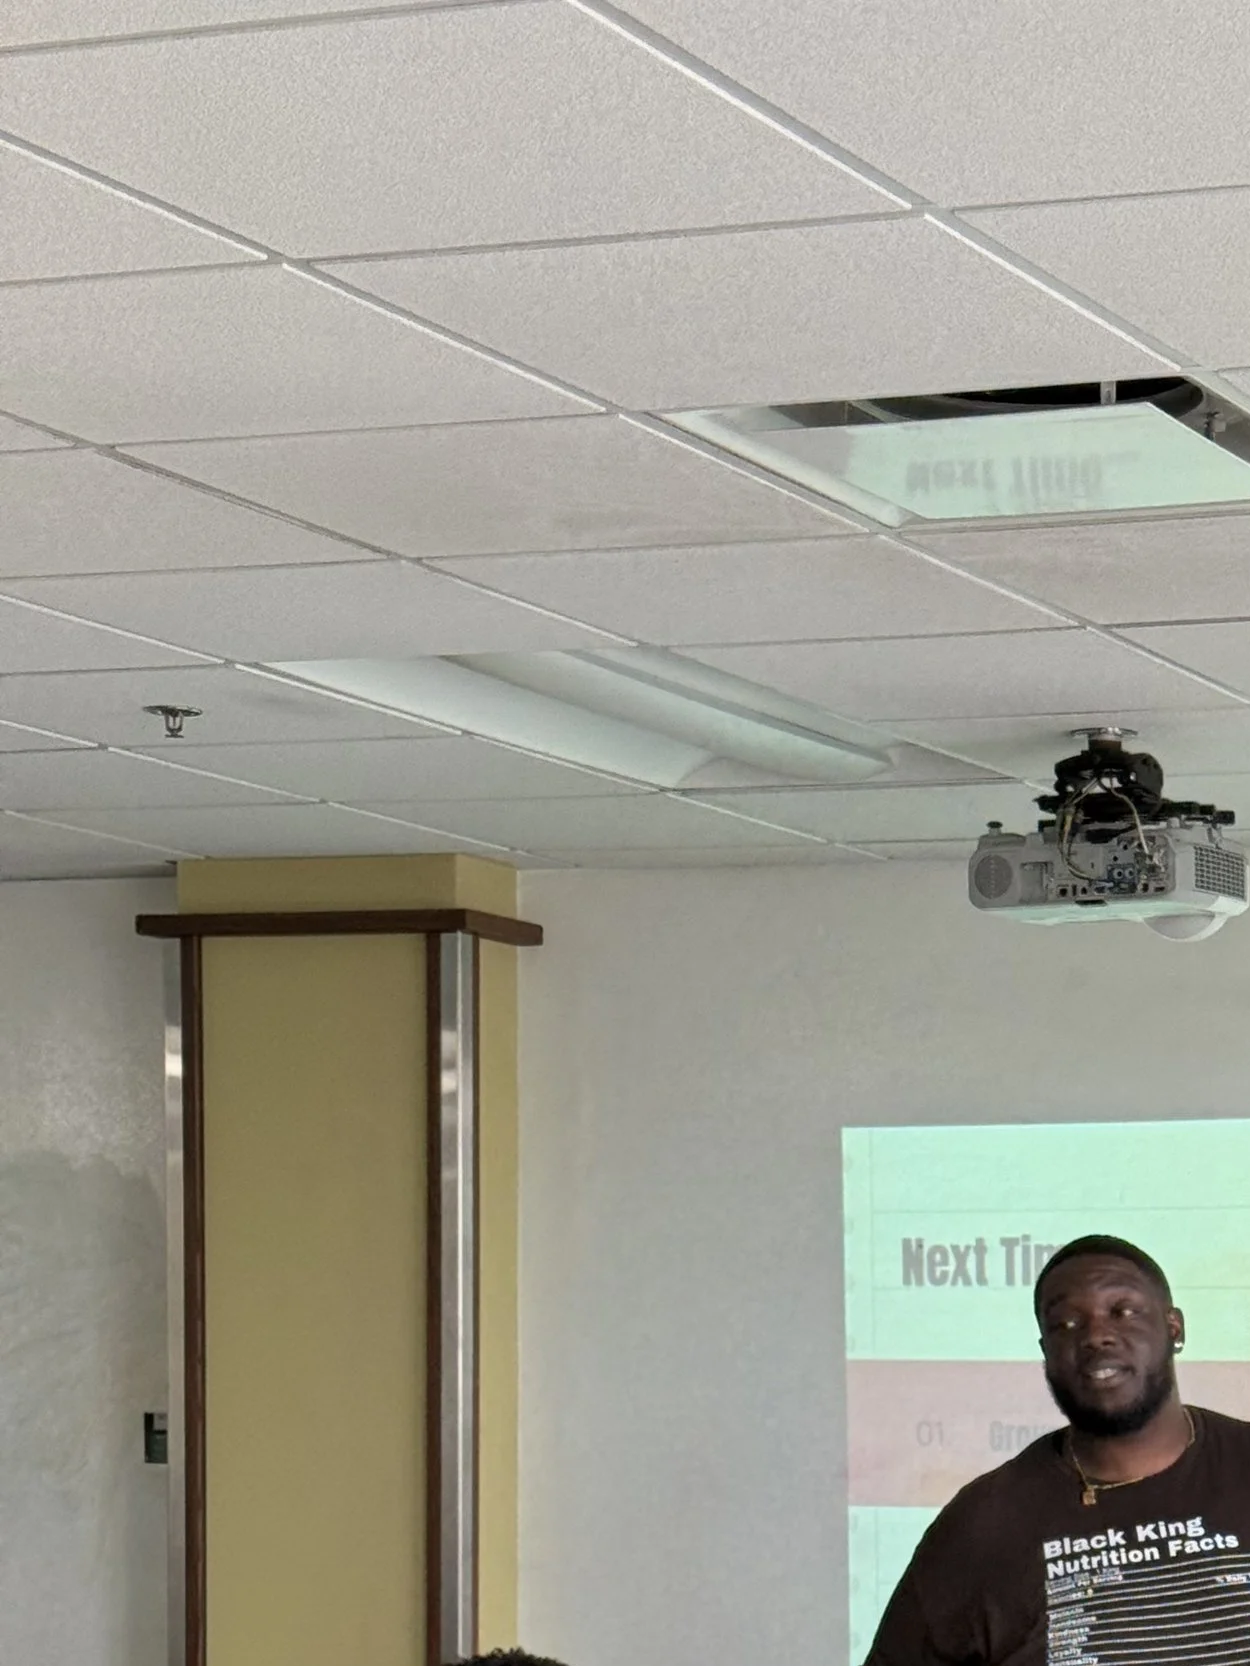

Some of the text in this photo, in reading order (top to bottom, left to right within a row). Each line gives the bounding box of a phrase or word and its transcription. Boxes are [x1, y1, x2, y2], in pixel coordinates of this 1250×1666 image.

[901, 1237, 989, 1287] Next
[1043, 1516, 1206, 1560] Black King
[1047, 1533, 1239, 1579] Nutrition Facts
